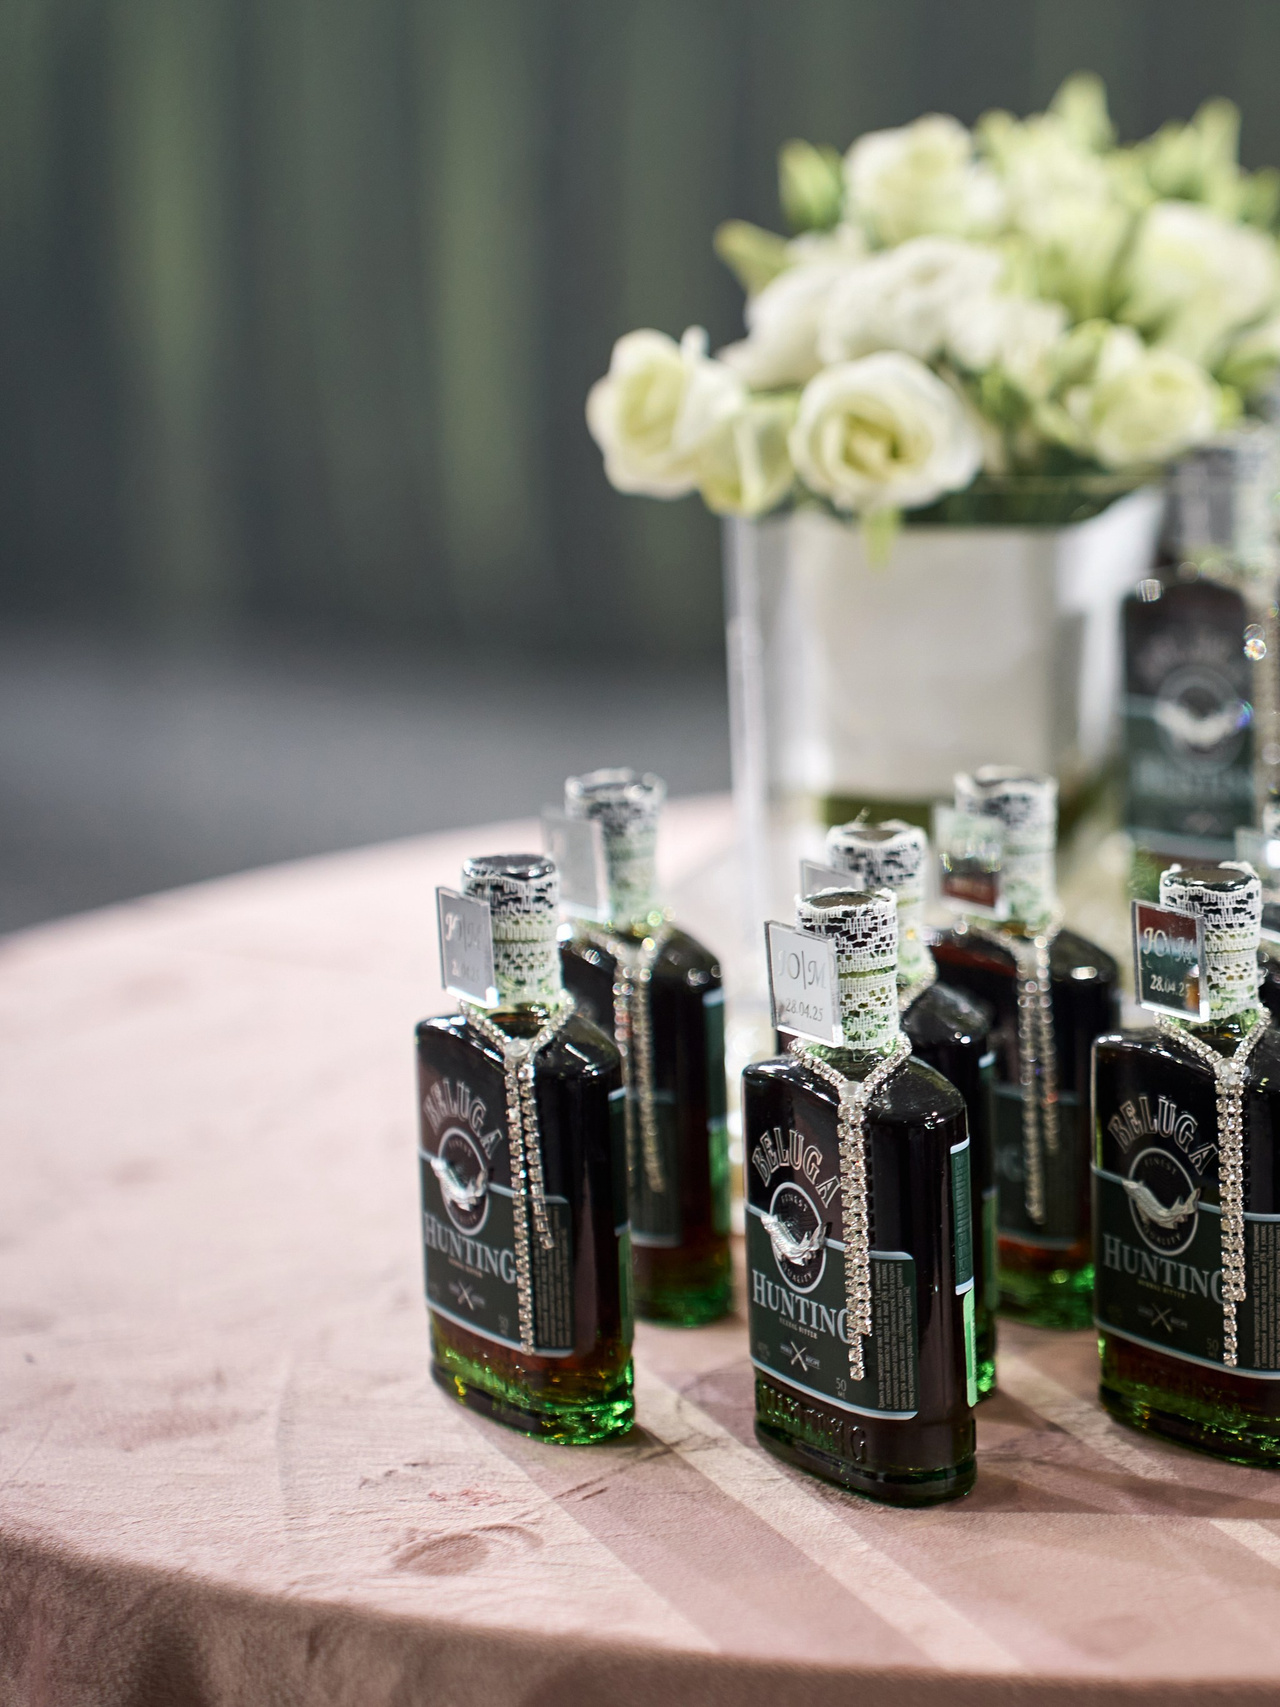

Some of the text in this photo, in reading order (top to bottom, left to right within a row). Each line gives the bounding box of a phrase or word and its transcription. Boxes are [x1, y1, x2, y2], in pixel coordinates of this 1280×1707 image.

[785, 998, 823, 1022] 28.04.25
[1149, 974, 1190, 998] 28.04.25
[424, 1077, 503, 1160] BELUGA
[1107, 1094, 1218, 1176] BELUGA
[752, 1127, 841, 1208] BELUGA
[424, 1211, 517, 1285] HUNTING
[835, 1377, 847, 1392] 50
